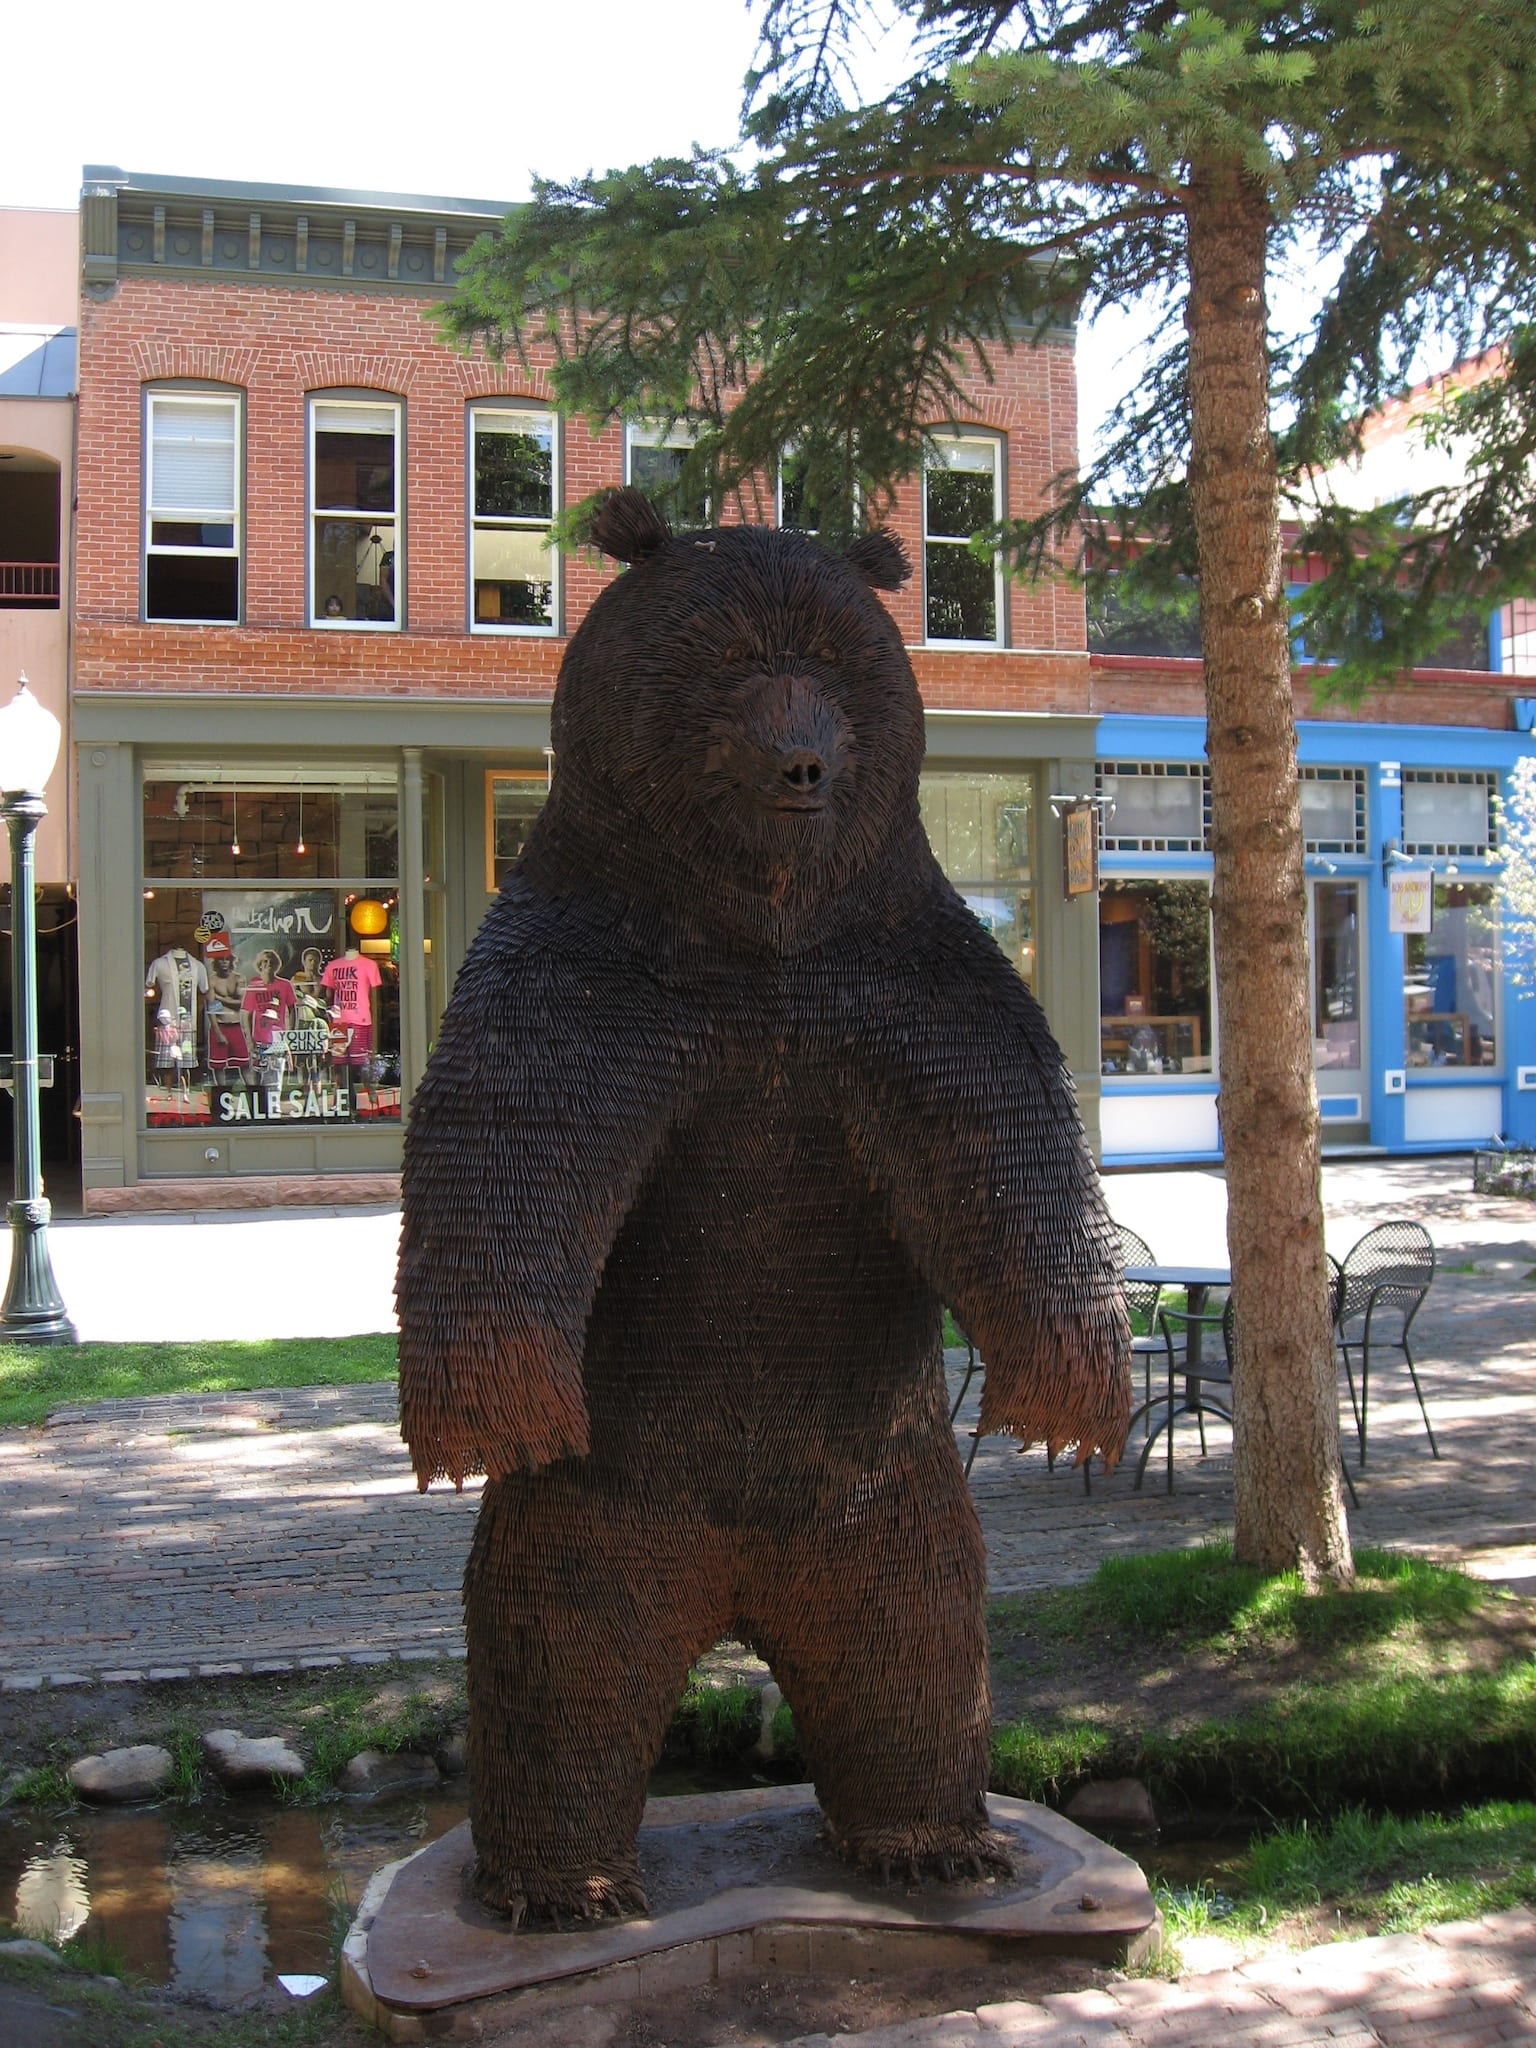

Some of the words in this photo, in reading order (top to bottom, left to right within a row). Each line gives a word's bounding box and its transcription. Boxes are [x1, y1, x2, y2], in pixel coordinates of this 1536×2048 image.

[279, 1031, 328, 1041] YOUNG
[288, 1040, 324, 1051] GUNS
[219, 1088, 281, 1121] SALE
[288, 1088, 350, 1118] SALE
